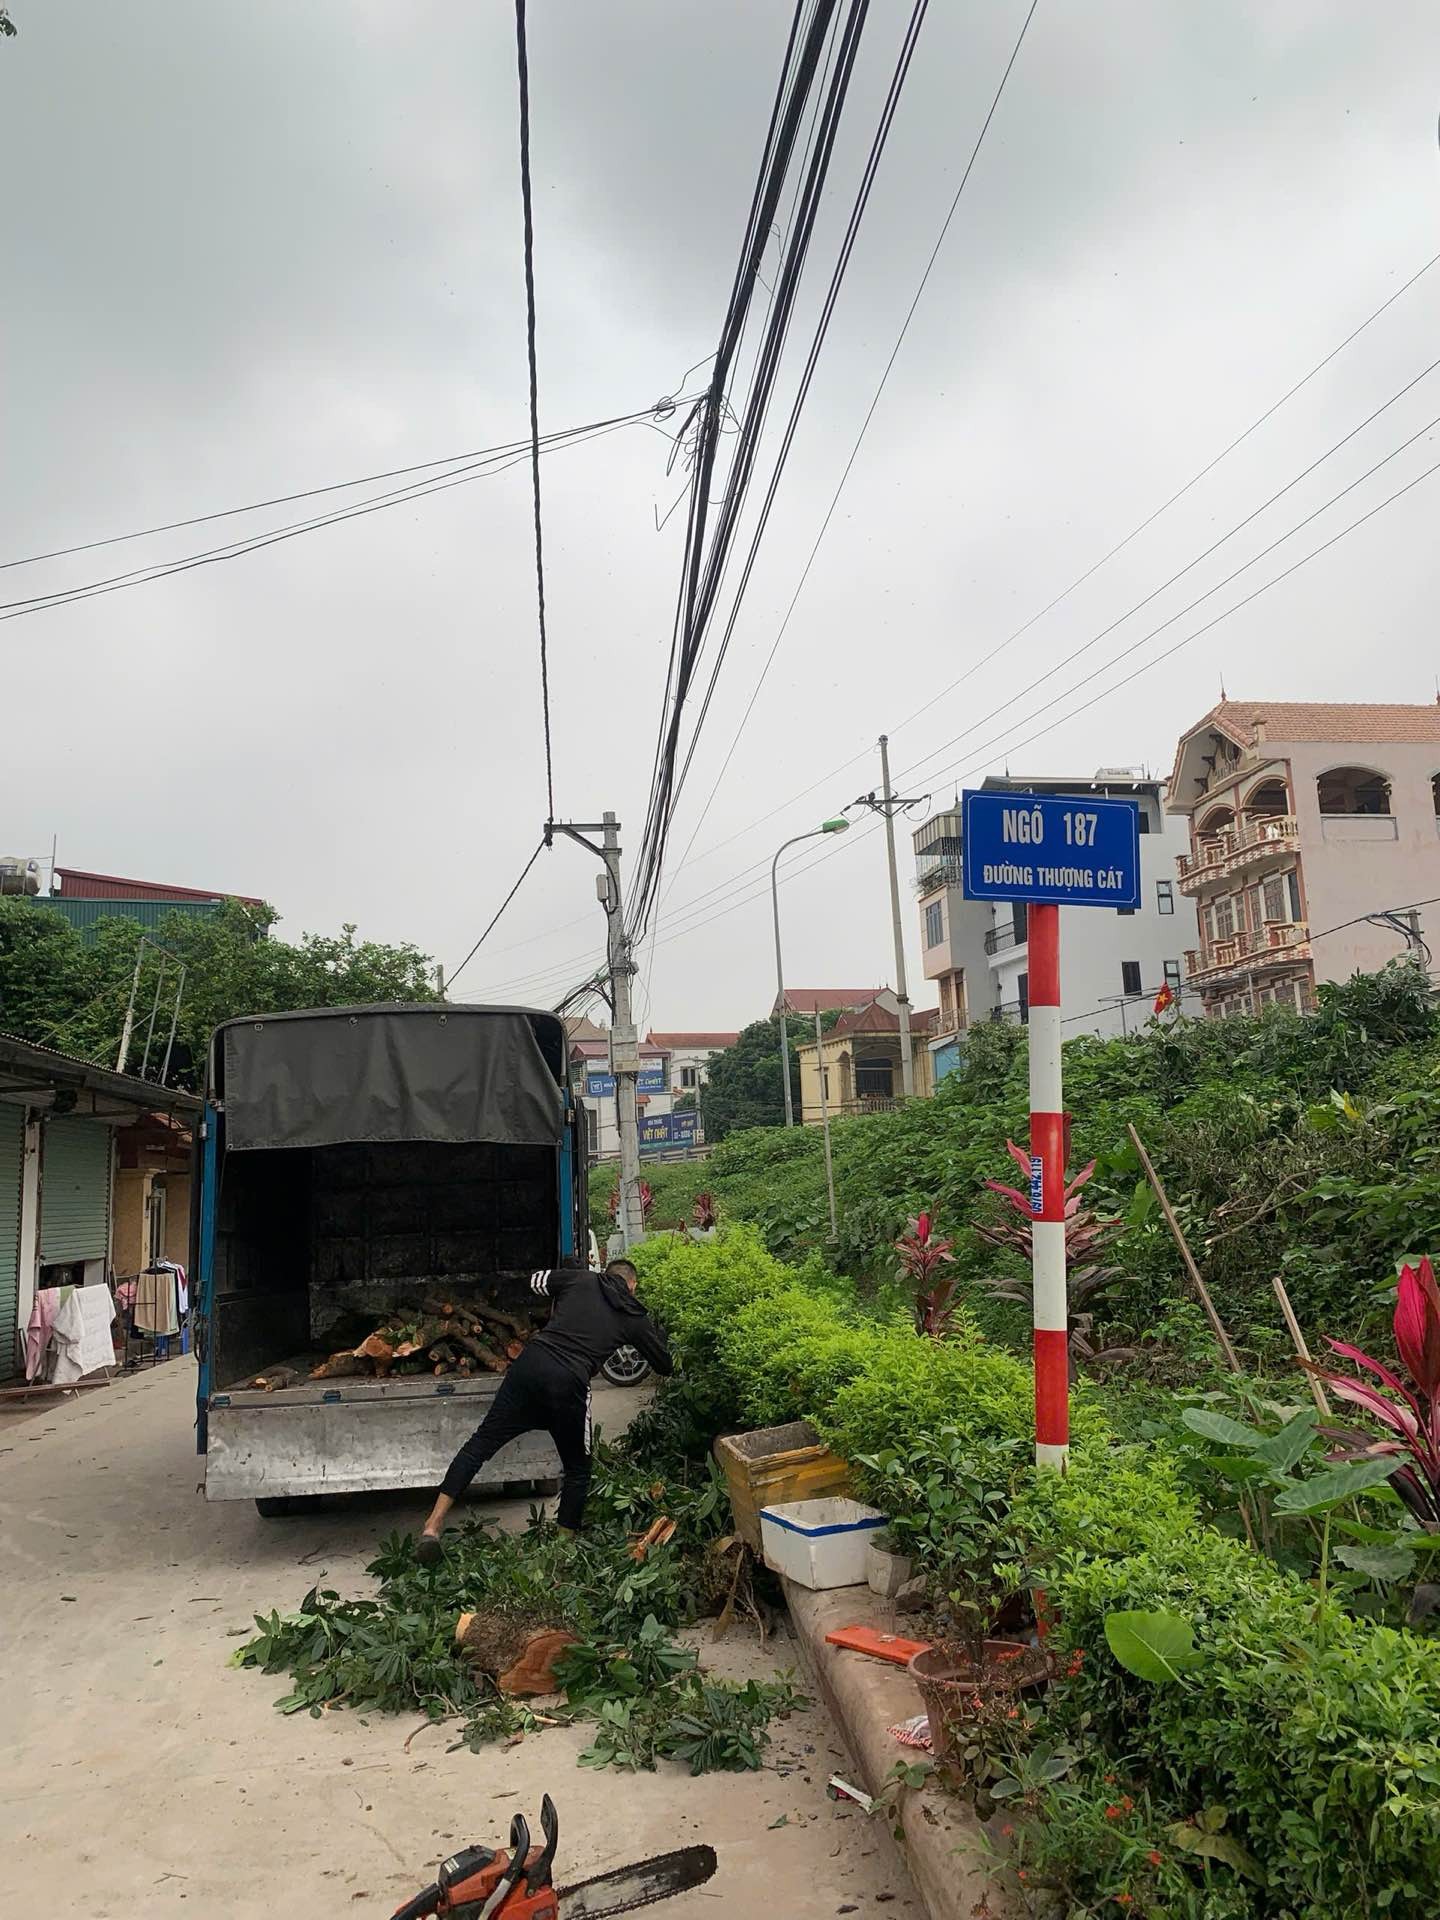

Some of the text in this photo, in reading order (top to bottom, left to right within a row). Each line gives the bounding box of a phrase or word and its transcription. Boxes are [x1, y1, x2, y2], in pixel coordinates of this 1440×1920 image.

[1002, 804, 1098, 847] NGÕ 187
[983, 860, 1124, 892] ĐƯỜNG THƯỢNG CÁT
